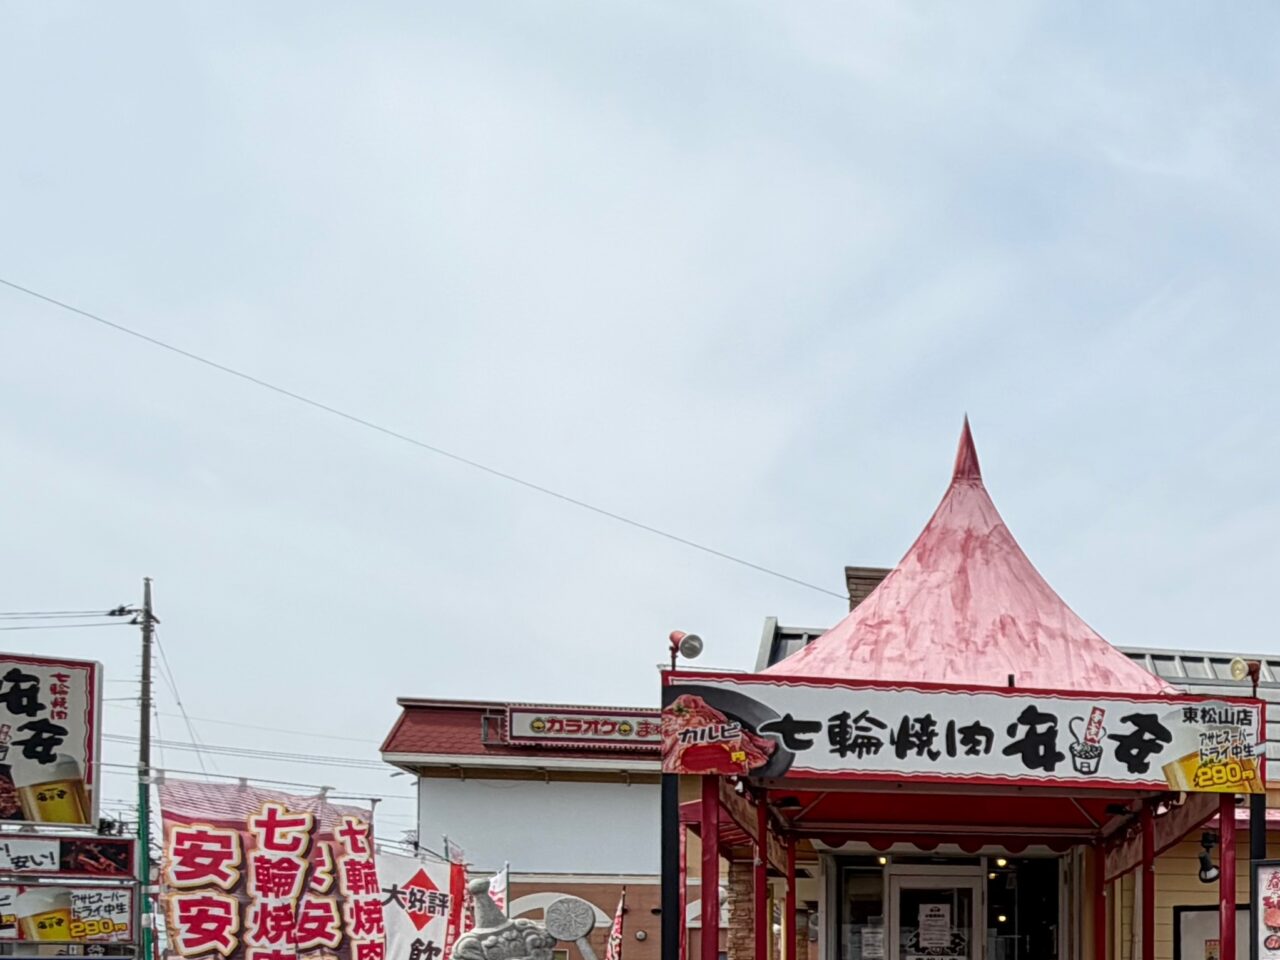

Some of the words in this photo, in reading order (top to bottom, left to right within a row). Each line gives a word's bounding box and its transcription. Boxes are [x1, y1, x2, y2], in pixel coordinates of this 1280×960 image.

[1182, 706, 1253, 727] 東松山店
[546, 718, 617, 735] カラオケ
[678, 722, 741, 743] カルビ
[759, 709, 994, 761] 七輪焼肉
[1199, 730, 1255, 747] アサヒスーパー
[1200, 745, 1259, 762] ドライ中生
[72, 891, 127, 904] アサヒスーパー
[382, 883, 450, 917] 大好評
[72, 902, 128, 919] ドライ中生
